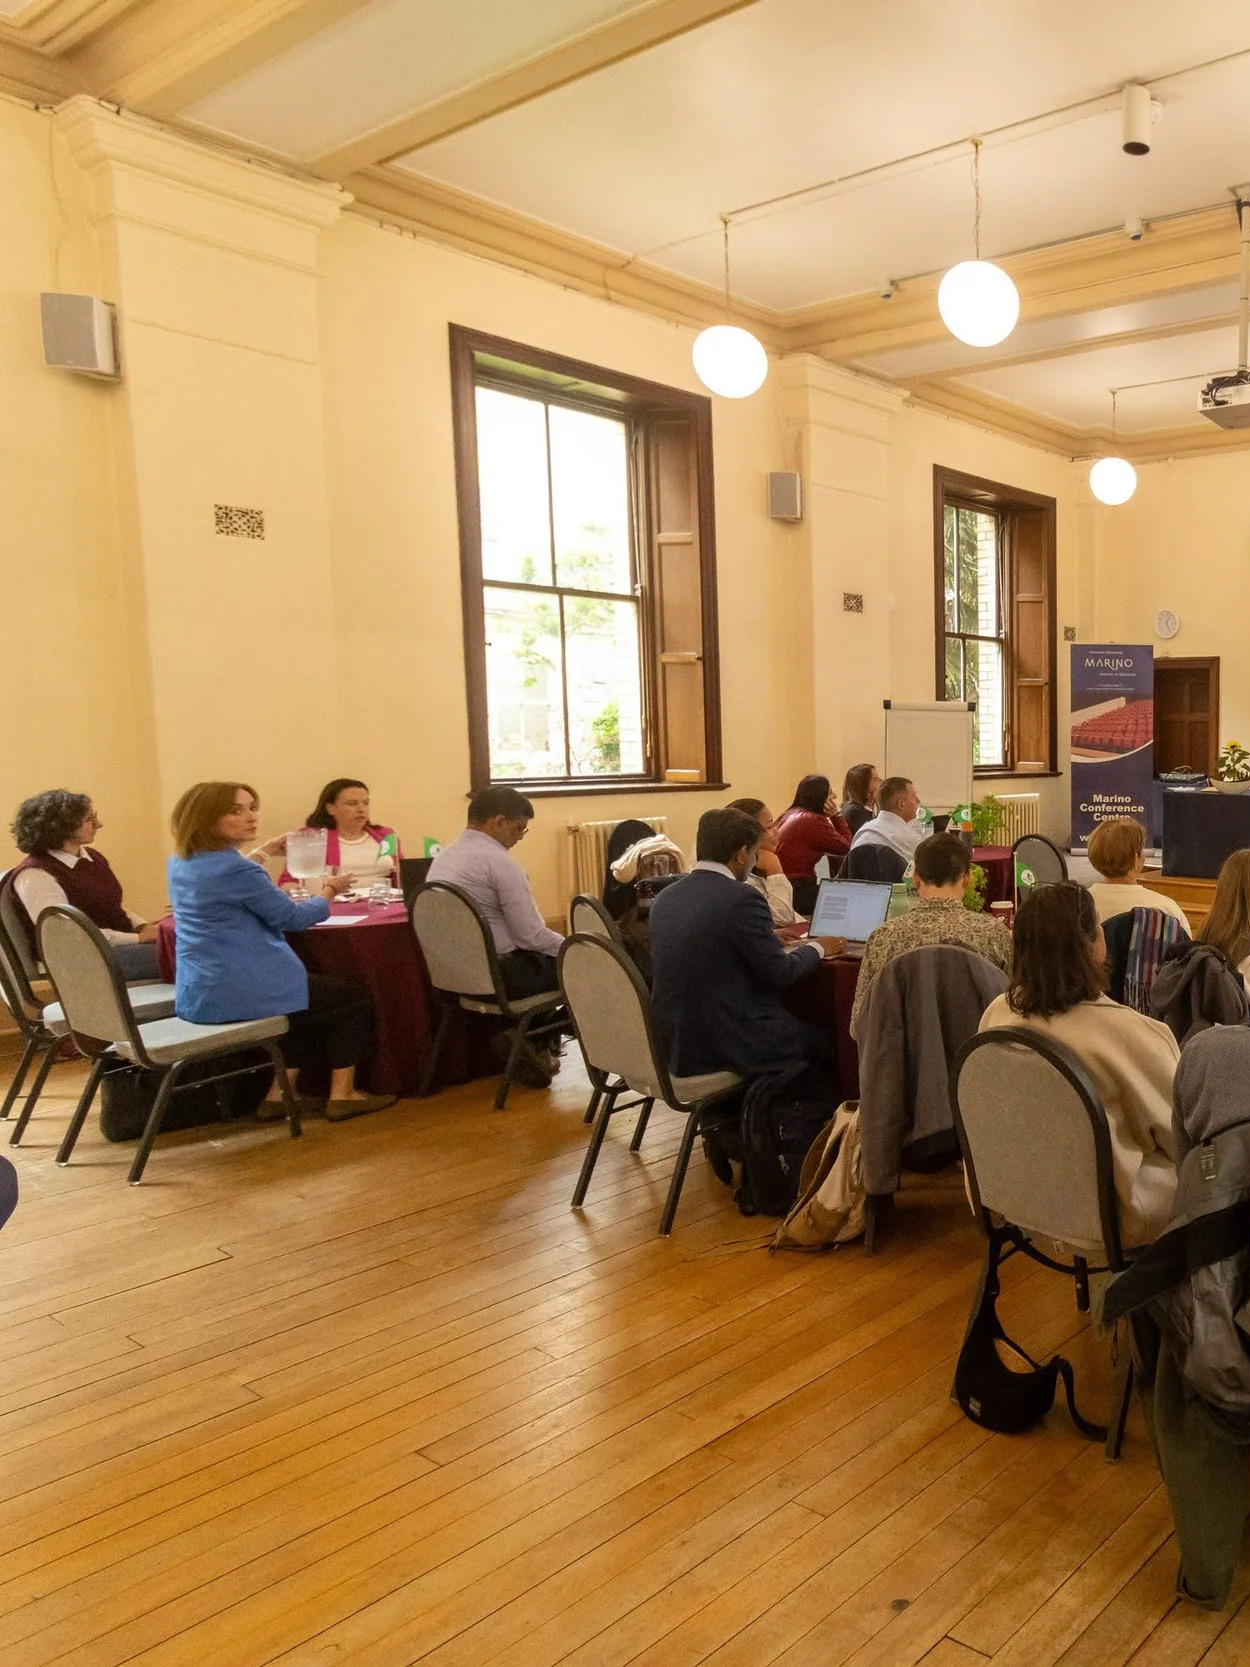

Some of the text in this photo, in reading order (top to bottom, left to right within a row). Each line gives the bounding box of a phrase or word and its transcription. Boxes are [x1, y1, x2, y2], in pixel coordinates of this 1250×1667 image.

[1085, 658, 1133, 671] MARINO
[1092, 794, 1132, 803] Marino
[1080, 803, 1145, 812] Conference
